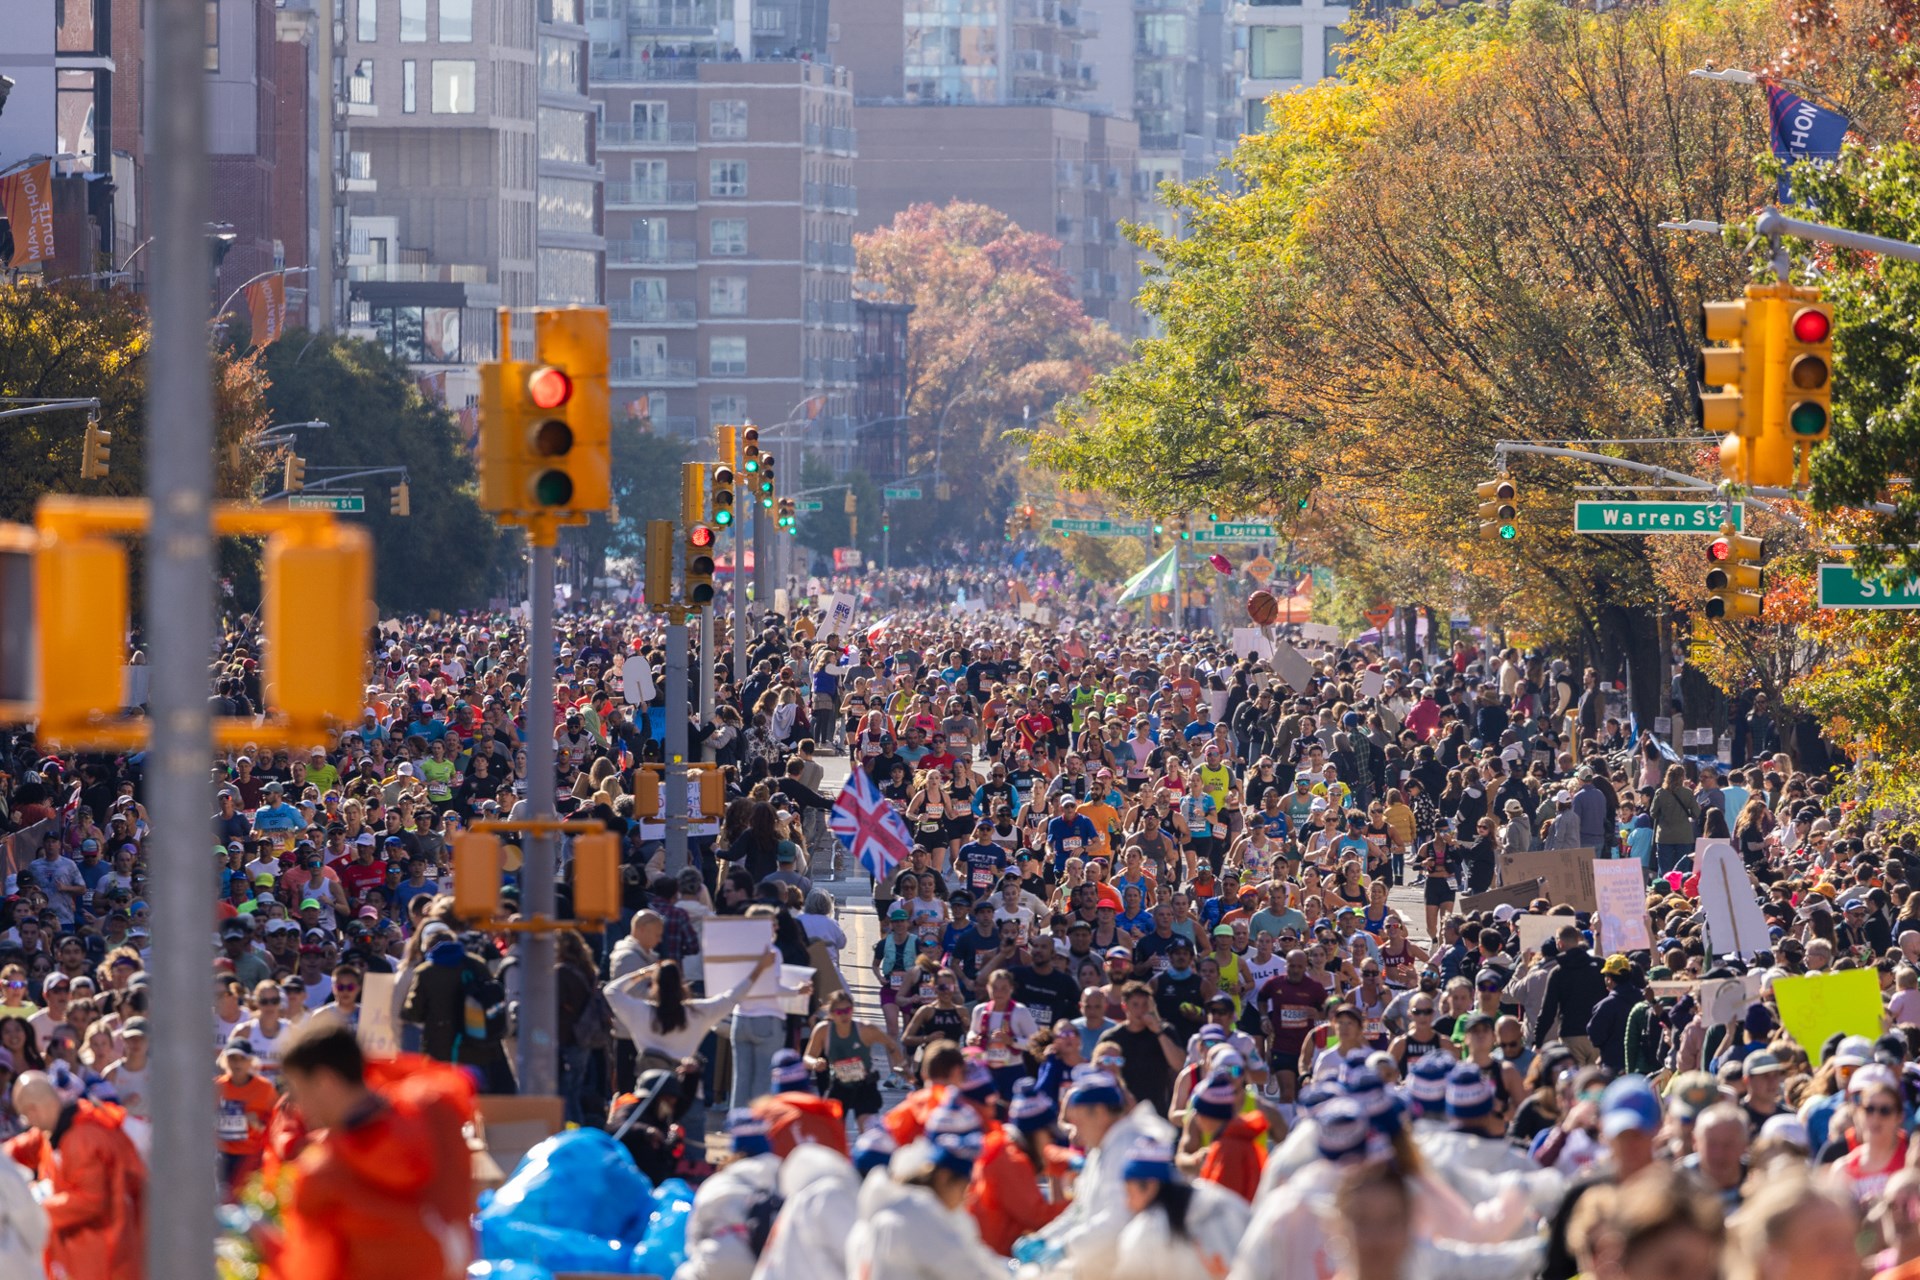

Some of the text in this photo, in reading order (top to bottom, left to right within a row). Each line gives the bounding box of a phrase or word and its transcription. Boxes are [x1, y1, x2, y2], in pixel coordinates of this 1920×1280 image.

[39, 201, 55, 257] ROUTE
[341, 499, 352, 509] St
[1602, 509, 1716, 526] Warren St
[1253, 968, 1279, 979] ILL-E
